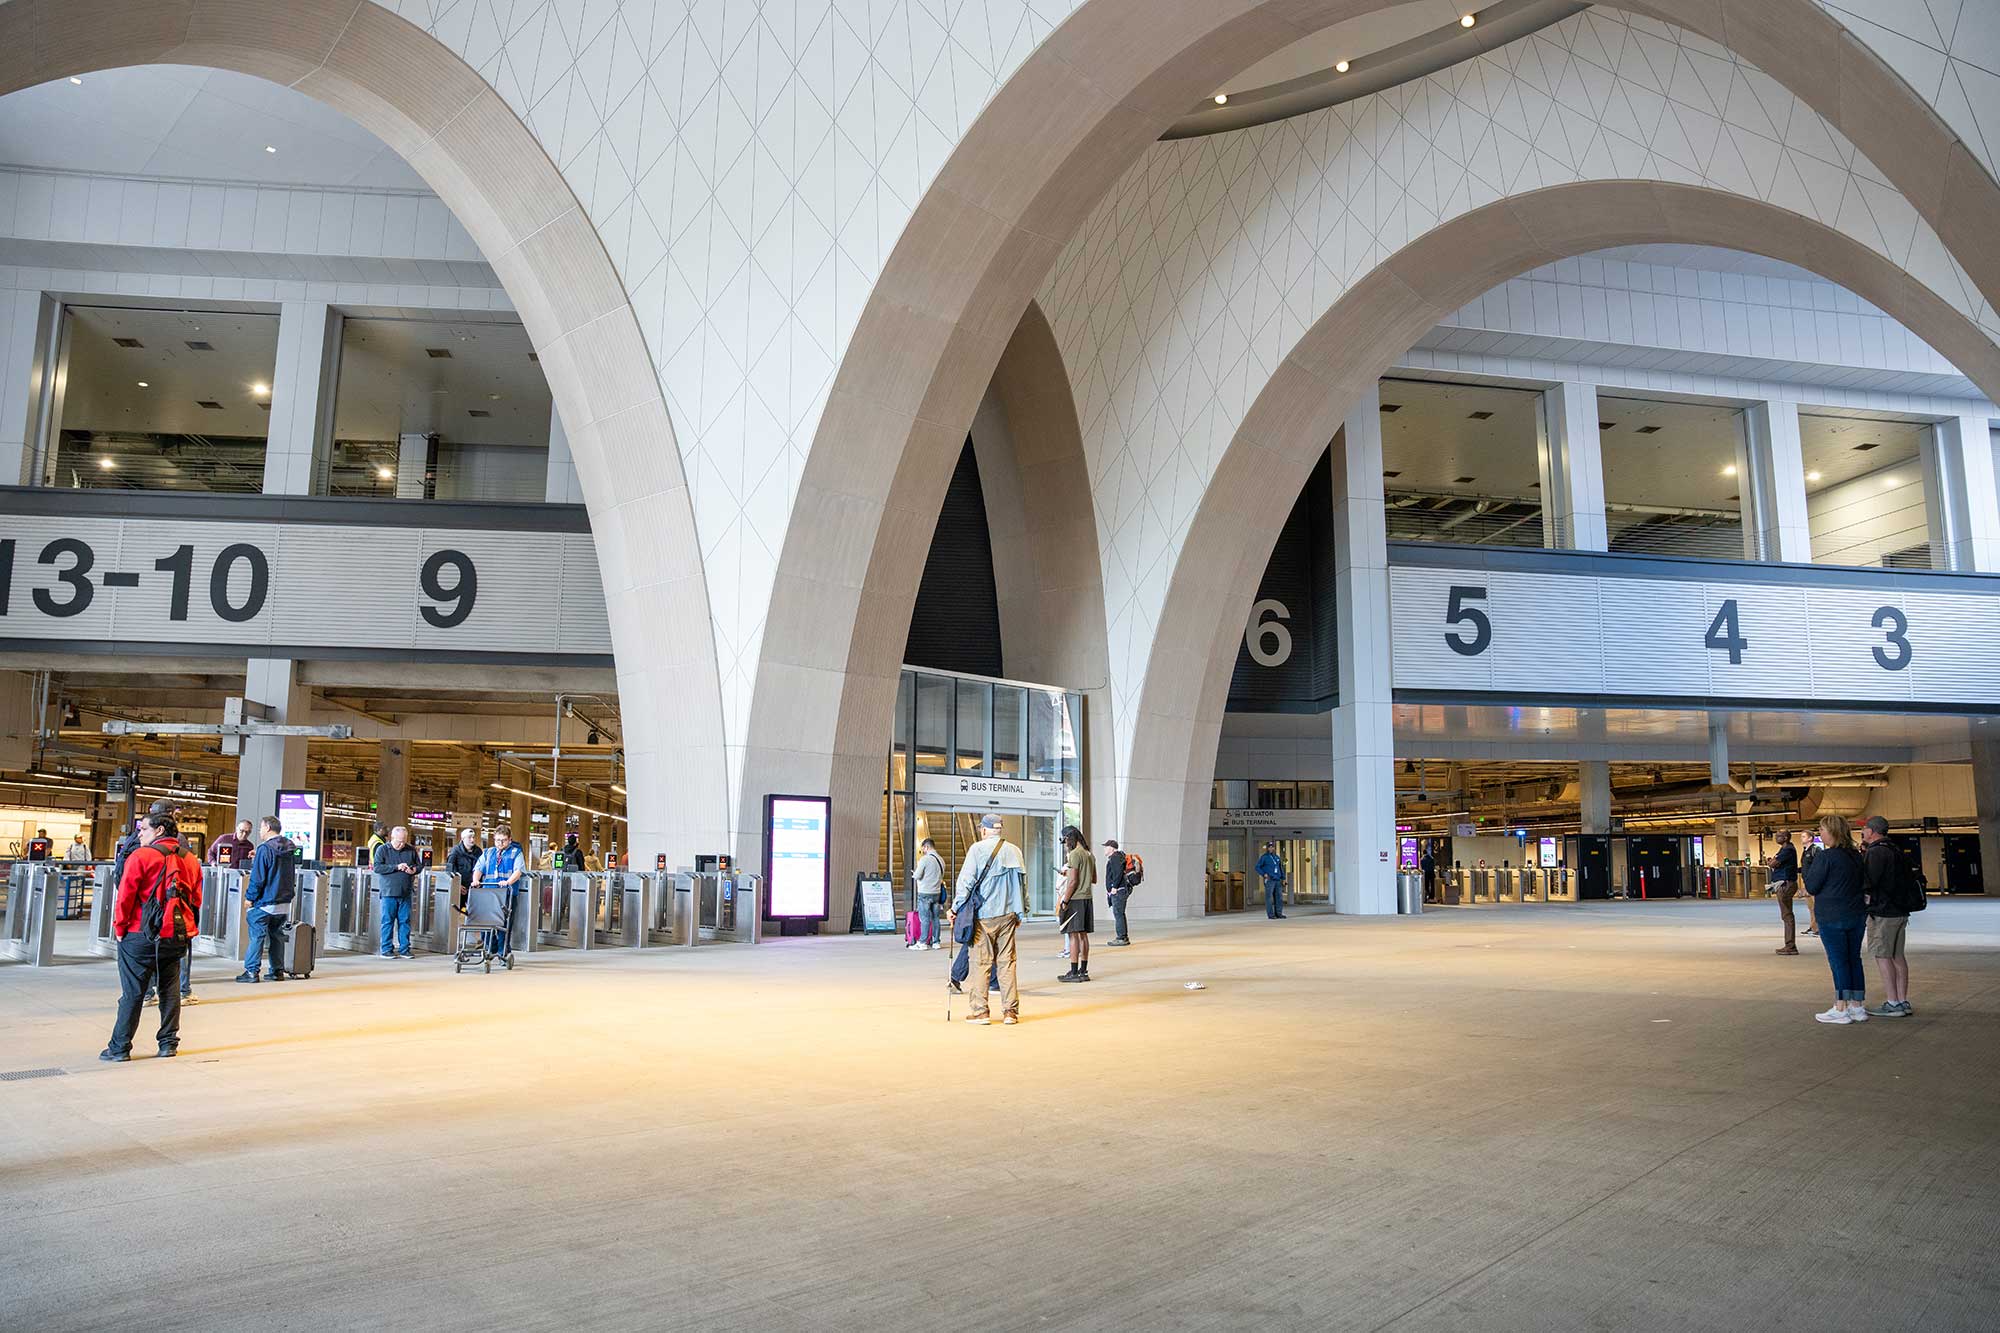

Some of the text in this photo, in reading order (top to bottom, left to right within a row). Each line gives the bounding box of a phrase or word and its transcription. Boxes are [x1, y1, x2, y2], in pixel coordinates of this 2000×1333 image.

[420, 549, 477, 629] 9
[1444, 585, 1492, 656] 5
[1245, 599, 1292, 667] 6
[1704, 599, 1748, 665] 4
[1871, 606, 1912, 671] 3
[971, 782, 1024, 793] BUS TERMINAL
